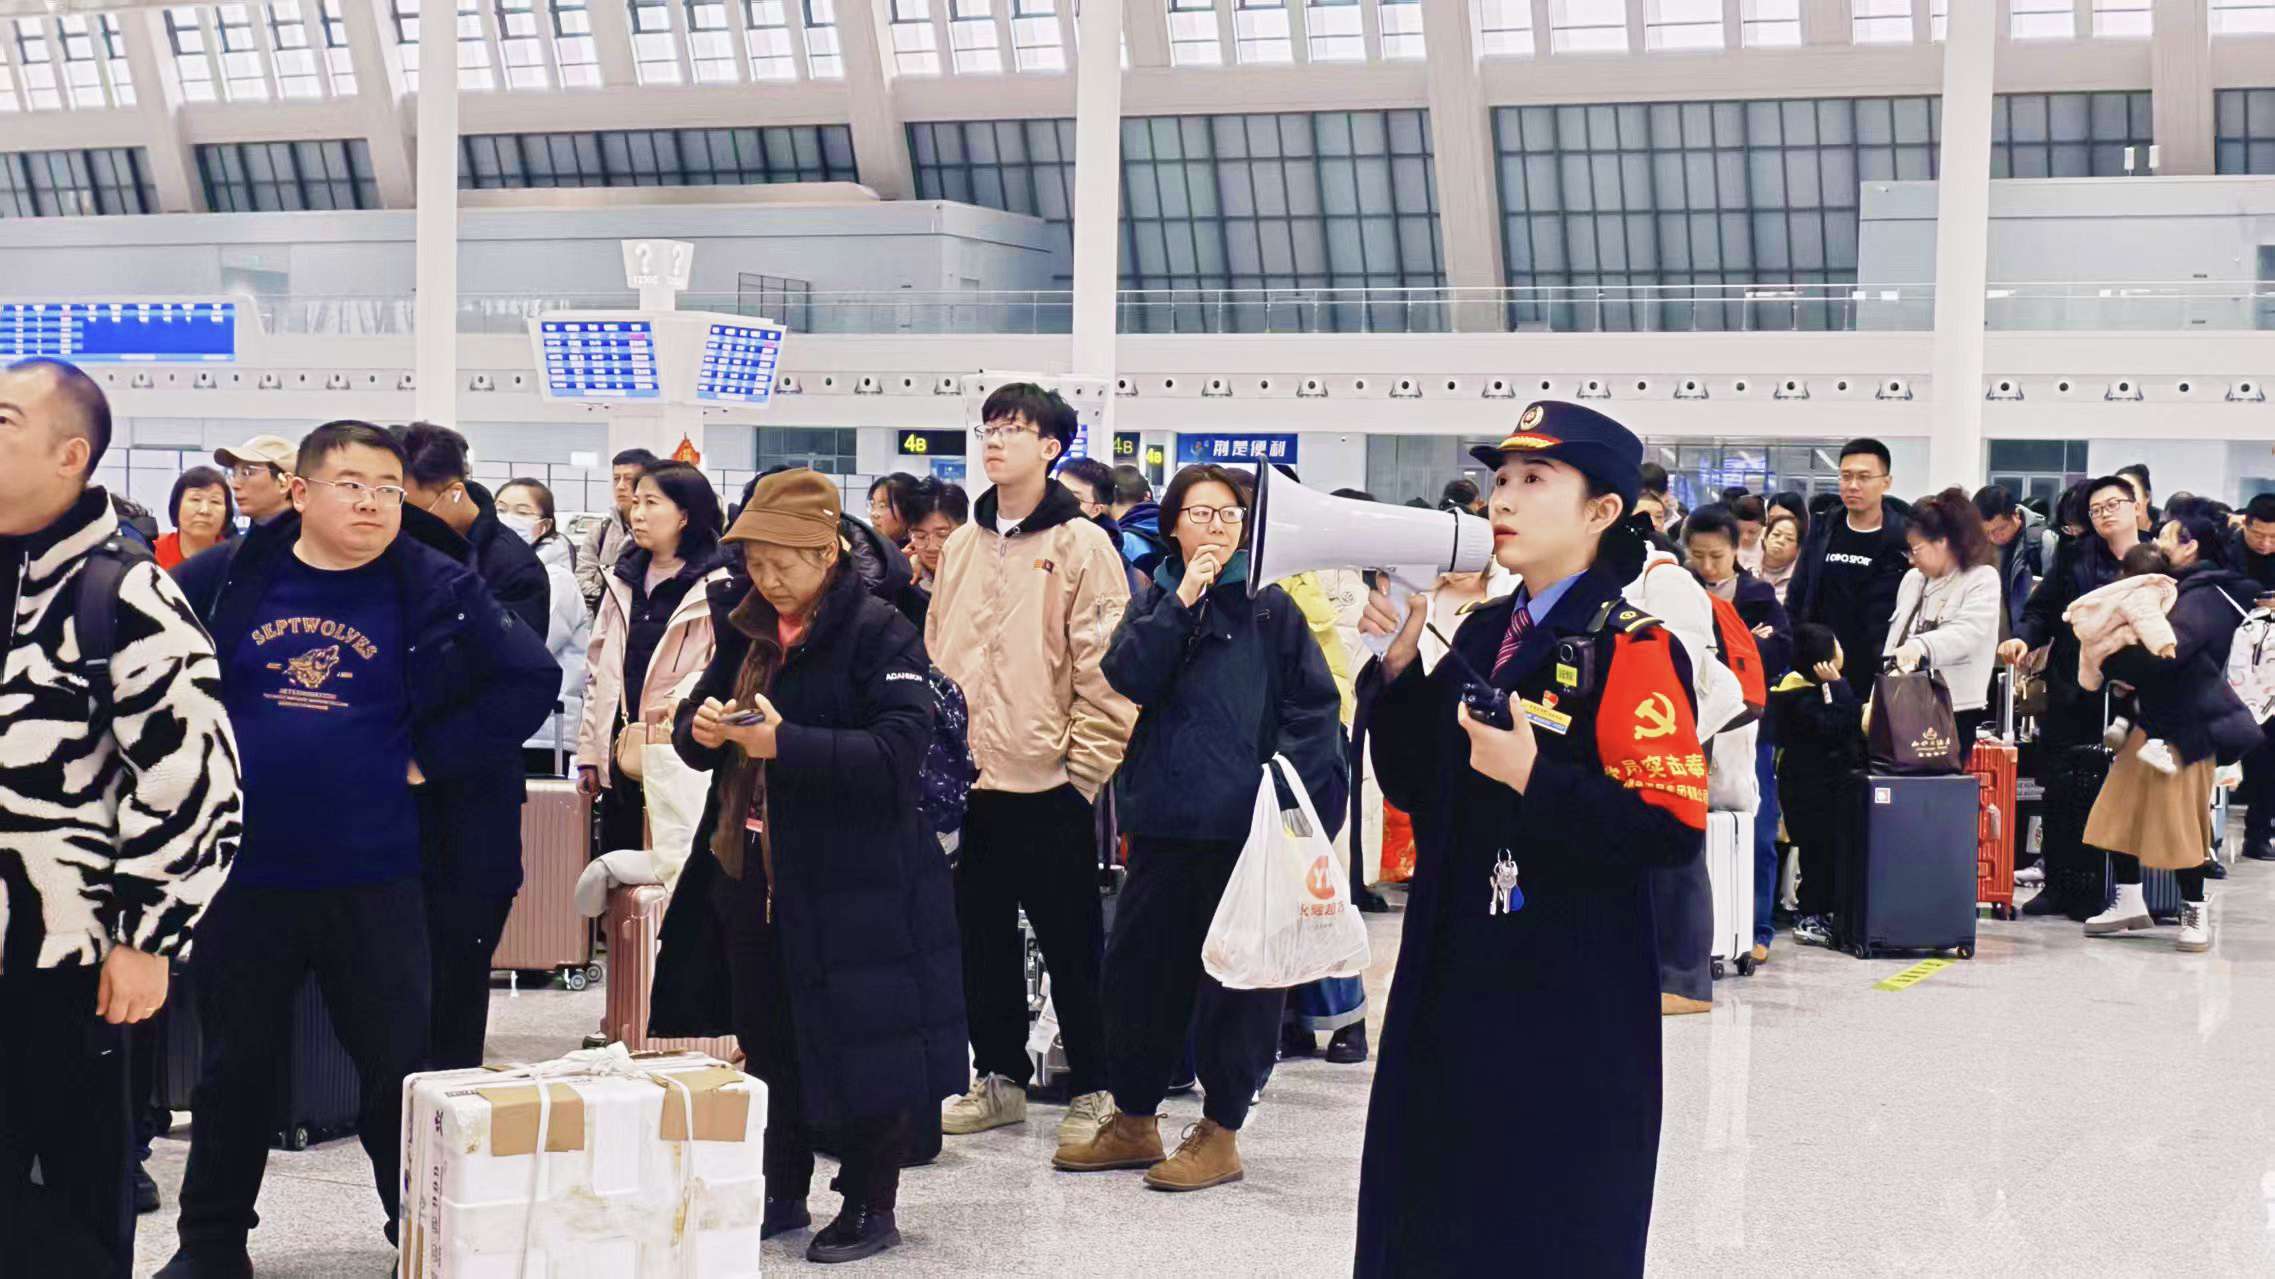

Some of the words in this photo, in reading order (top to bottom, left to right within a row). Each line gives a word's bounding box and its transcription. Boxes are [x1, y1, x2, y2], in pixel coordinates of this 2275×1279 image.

[904, 433, 928, 452] 4B
[1113, 436, 1133, 454] 4B
[1147, 447, 1162, 464] 4B
[251, 617, 378, 660] SEPTWOLVES
